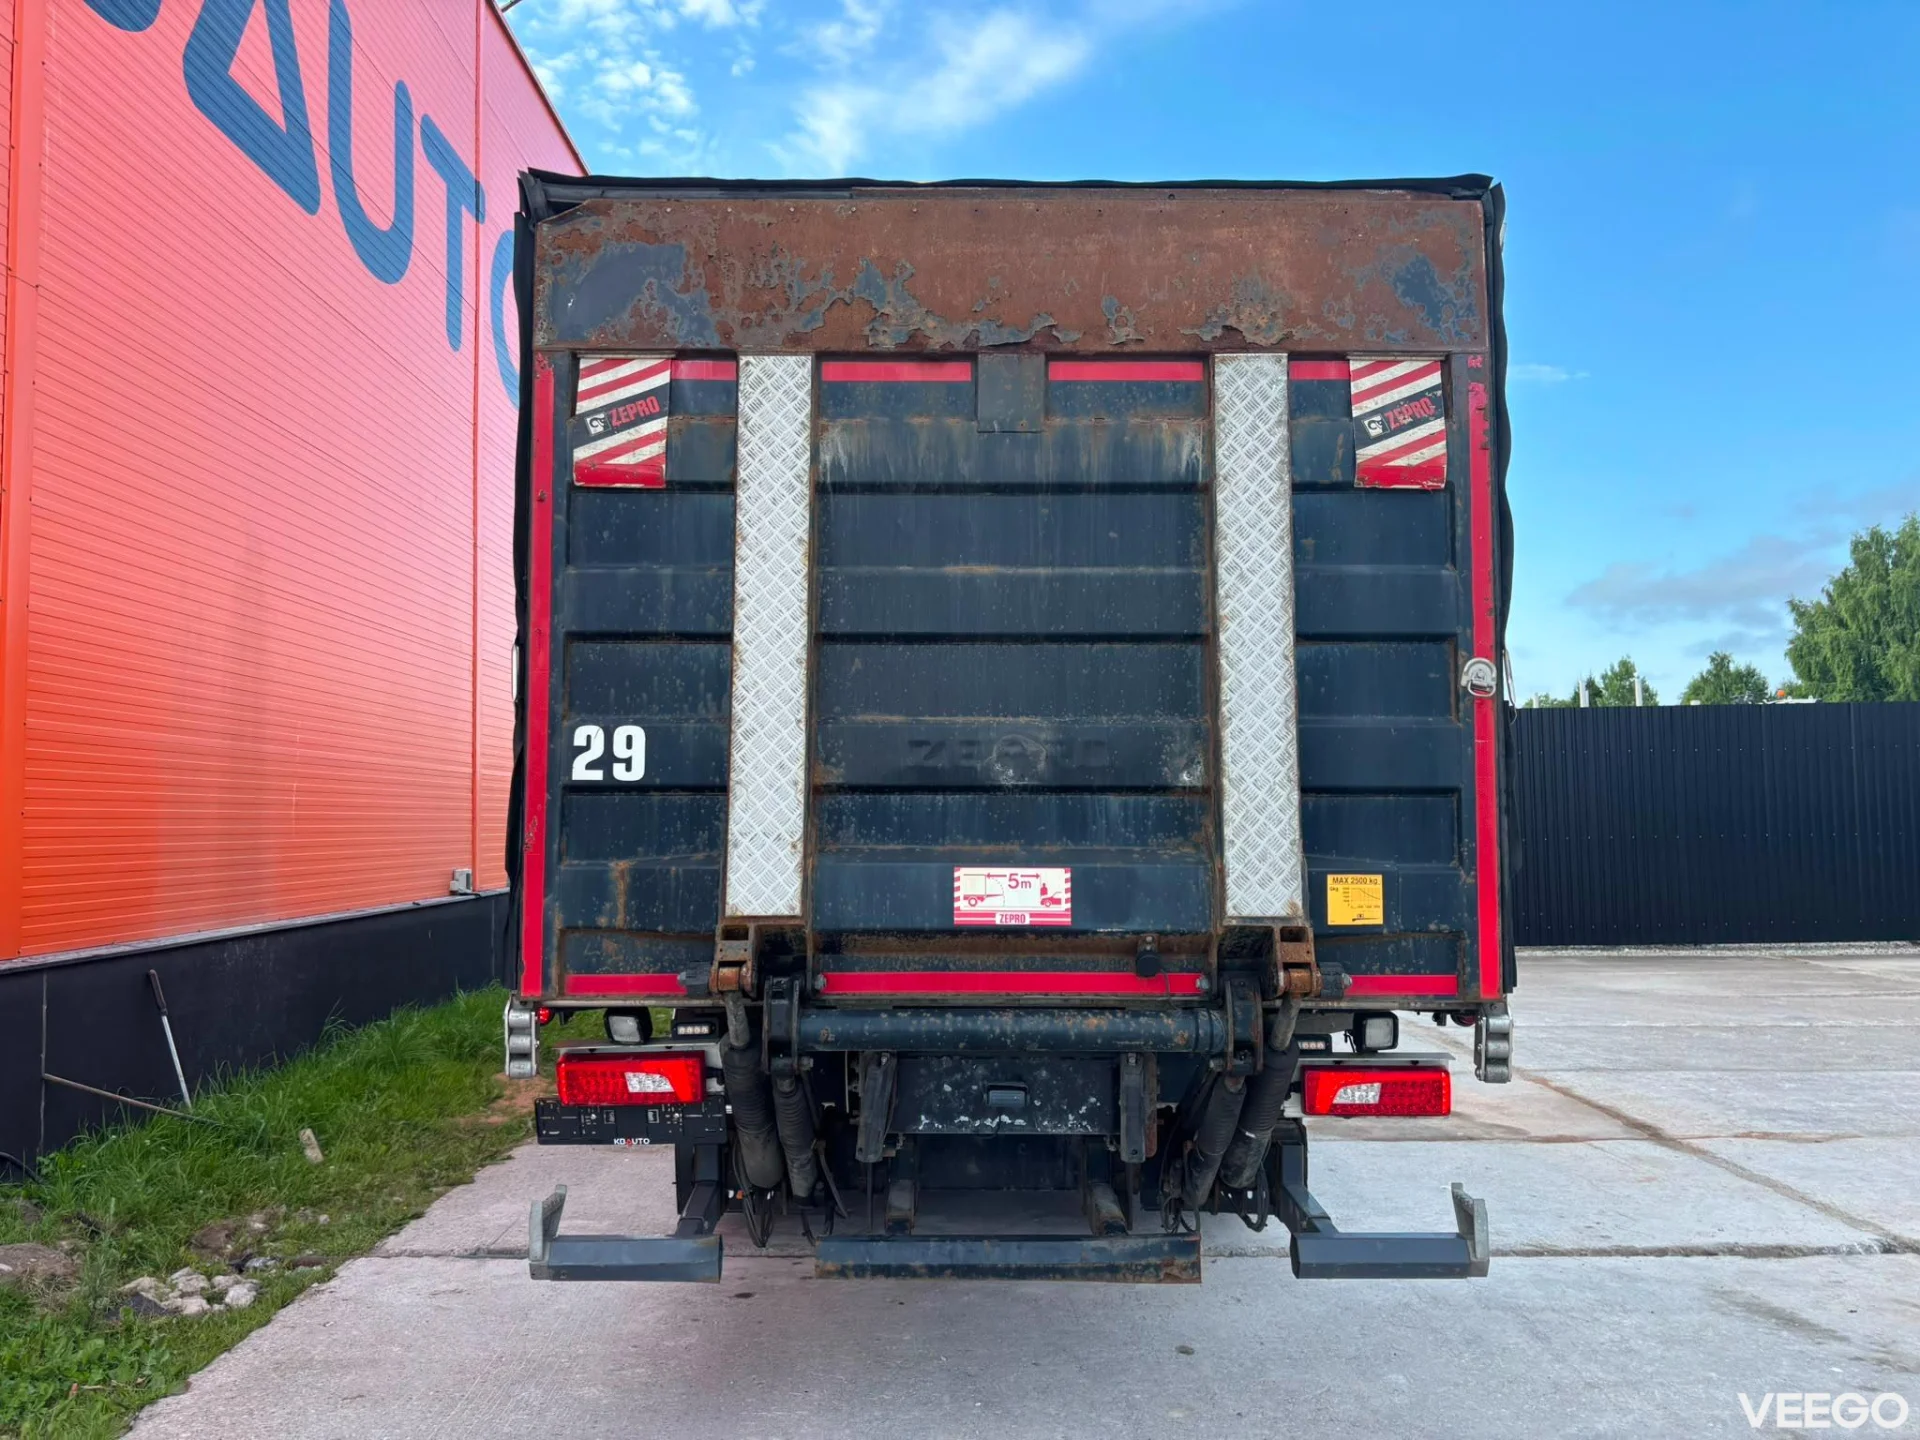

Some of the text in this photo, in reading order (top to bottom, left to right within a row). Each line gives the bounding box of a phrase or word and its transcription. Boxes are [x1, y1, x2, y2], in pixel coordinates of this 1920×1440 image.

[610, 395, 660, 427] ZEPRO
[1384, 397, 1436, 429] ZEPRO
[572, 725, 646, 781] 29
[1369, 877, 1378, 885] kg
[999, 913, 1026, 924] ZEPRO
